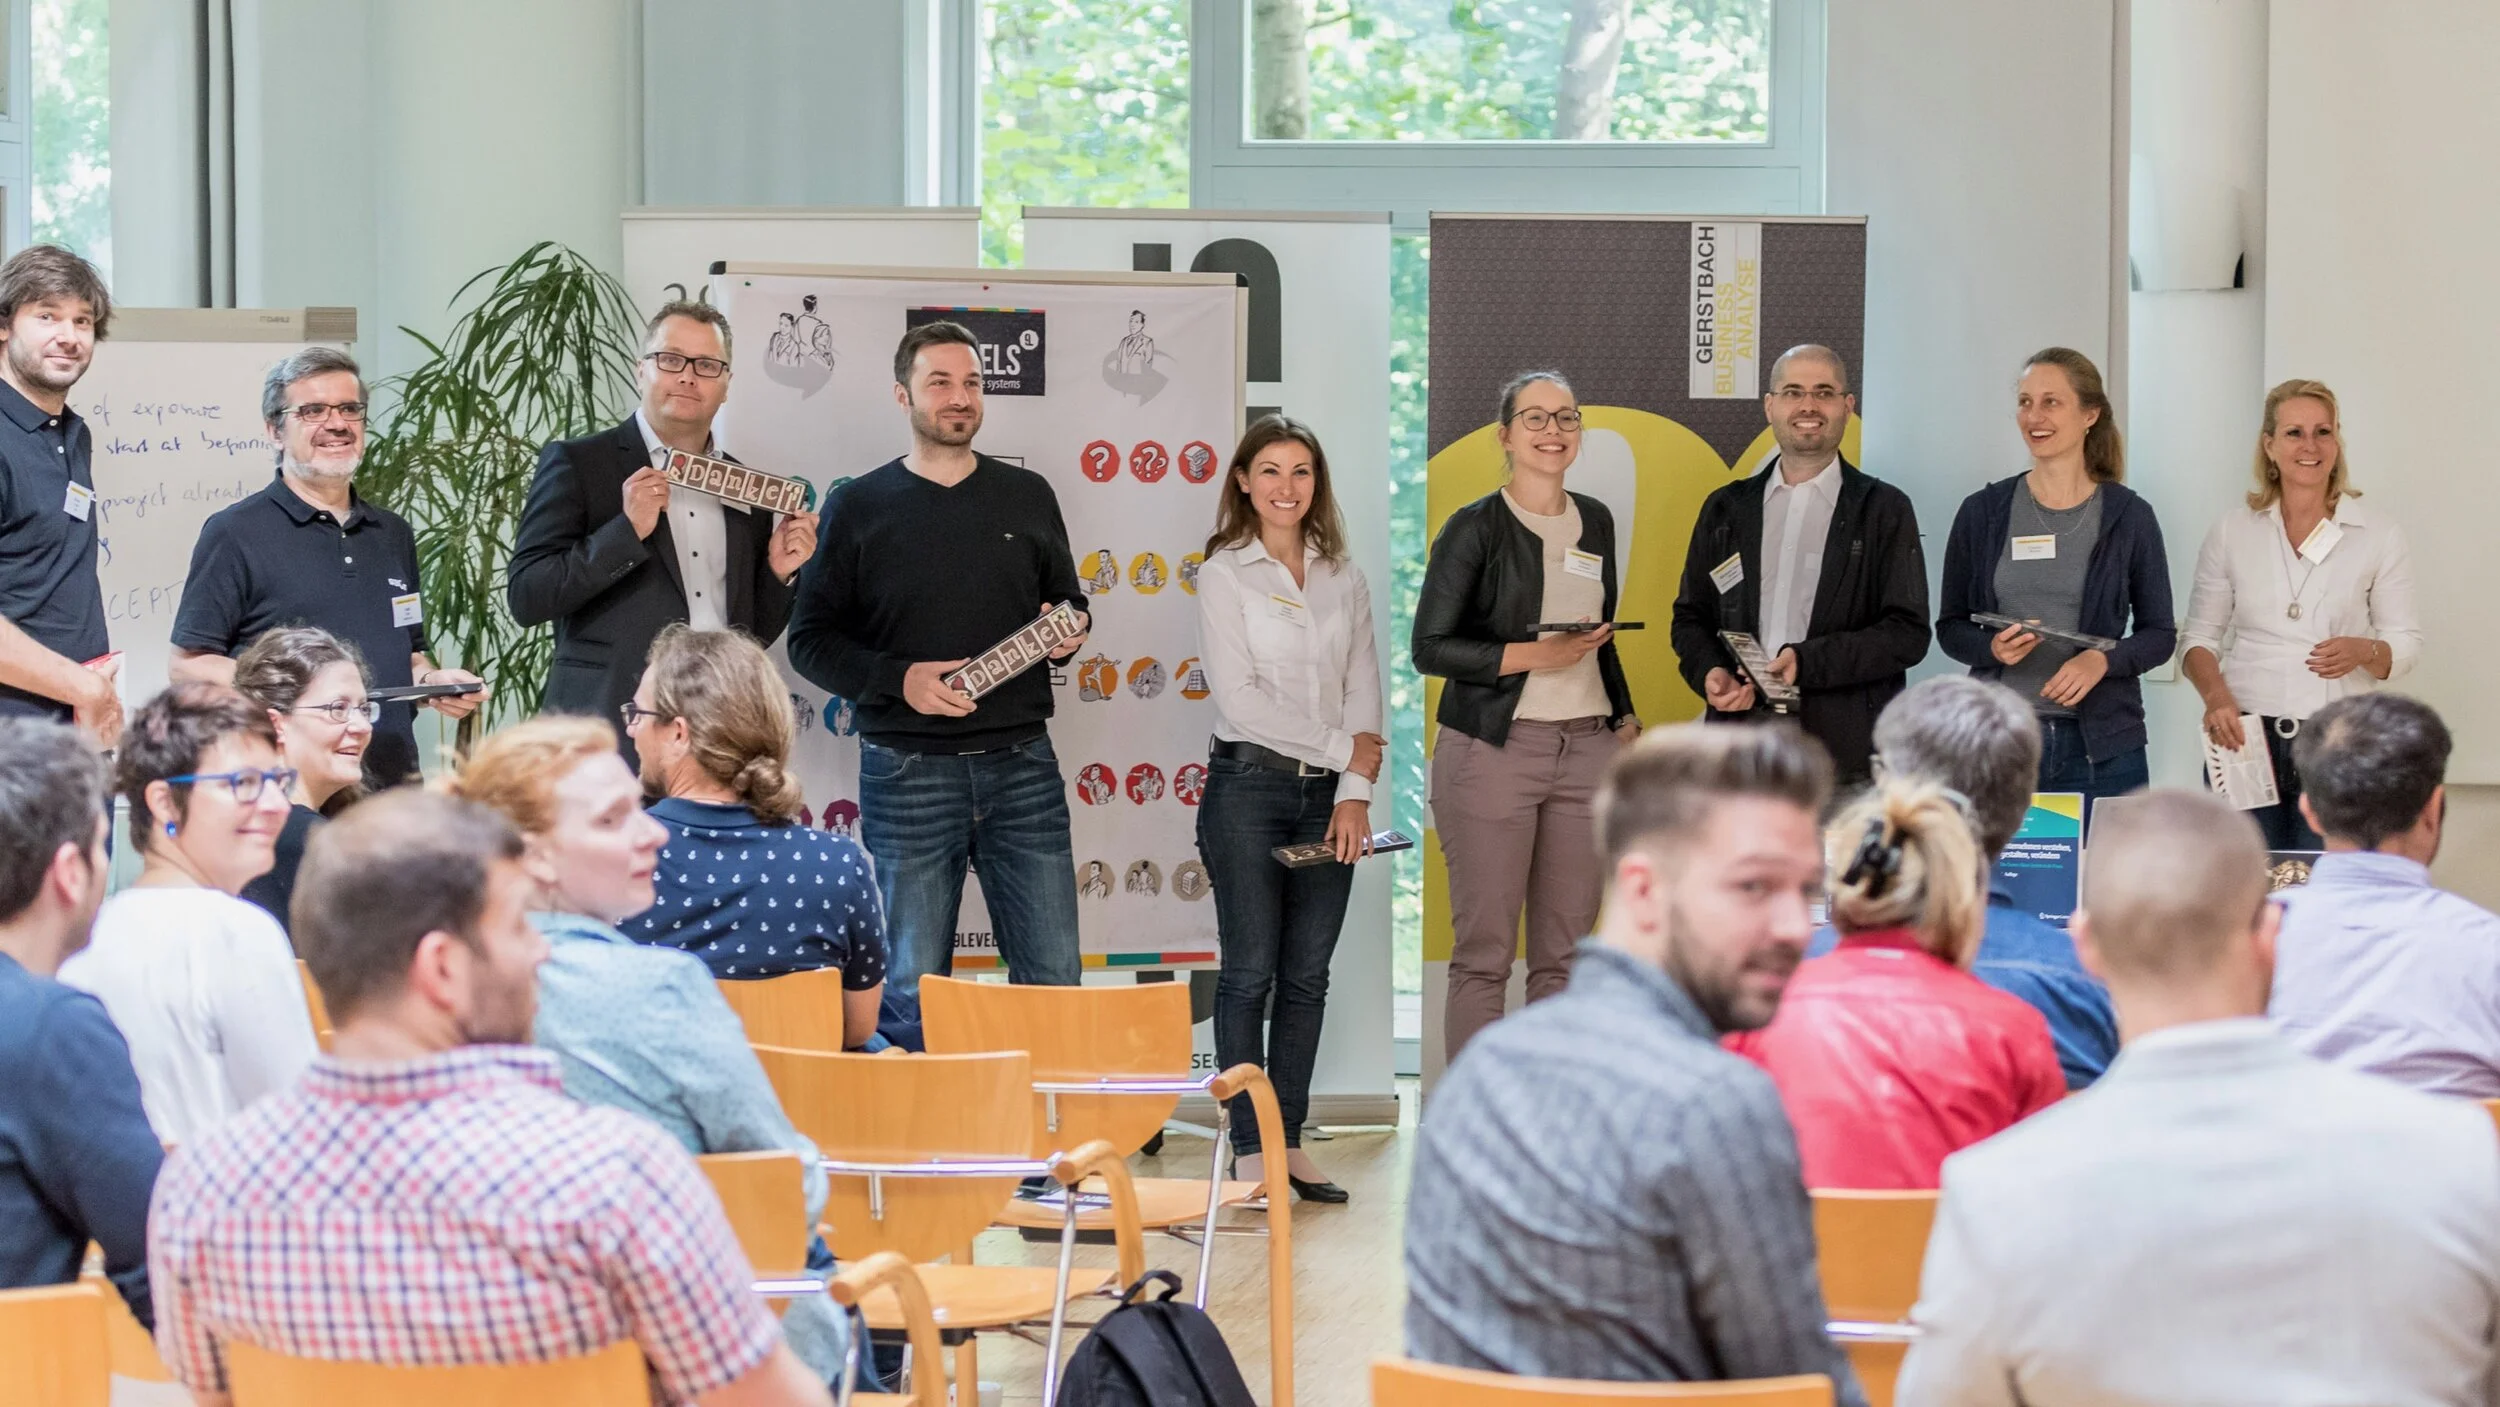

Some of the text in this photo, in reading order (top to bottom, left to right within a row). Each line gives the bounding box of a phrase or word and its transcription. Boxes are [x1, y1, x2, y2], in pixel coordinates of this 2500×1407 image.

[1696, 226, 1714, 364] GERSTBACH
[1736, 259, 1756, 360] ANALYSE
[1716, 282, 1734, 395] BUSINESS
[986, 379, 1021, 391] systems
[93, 393, 111, 426] of
[161, 437, 181, 451] at
[101, 482, 166, 523] project
